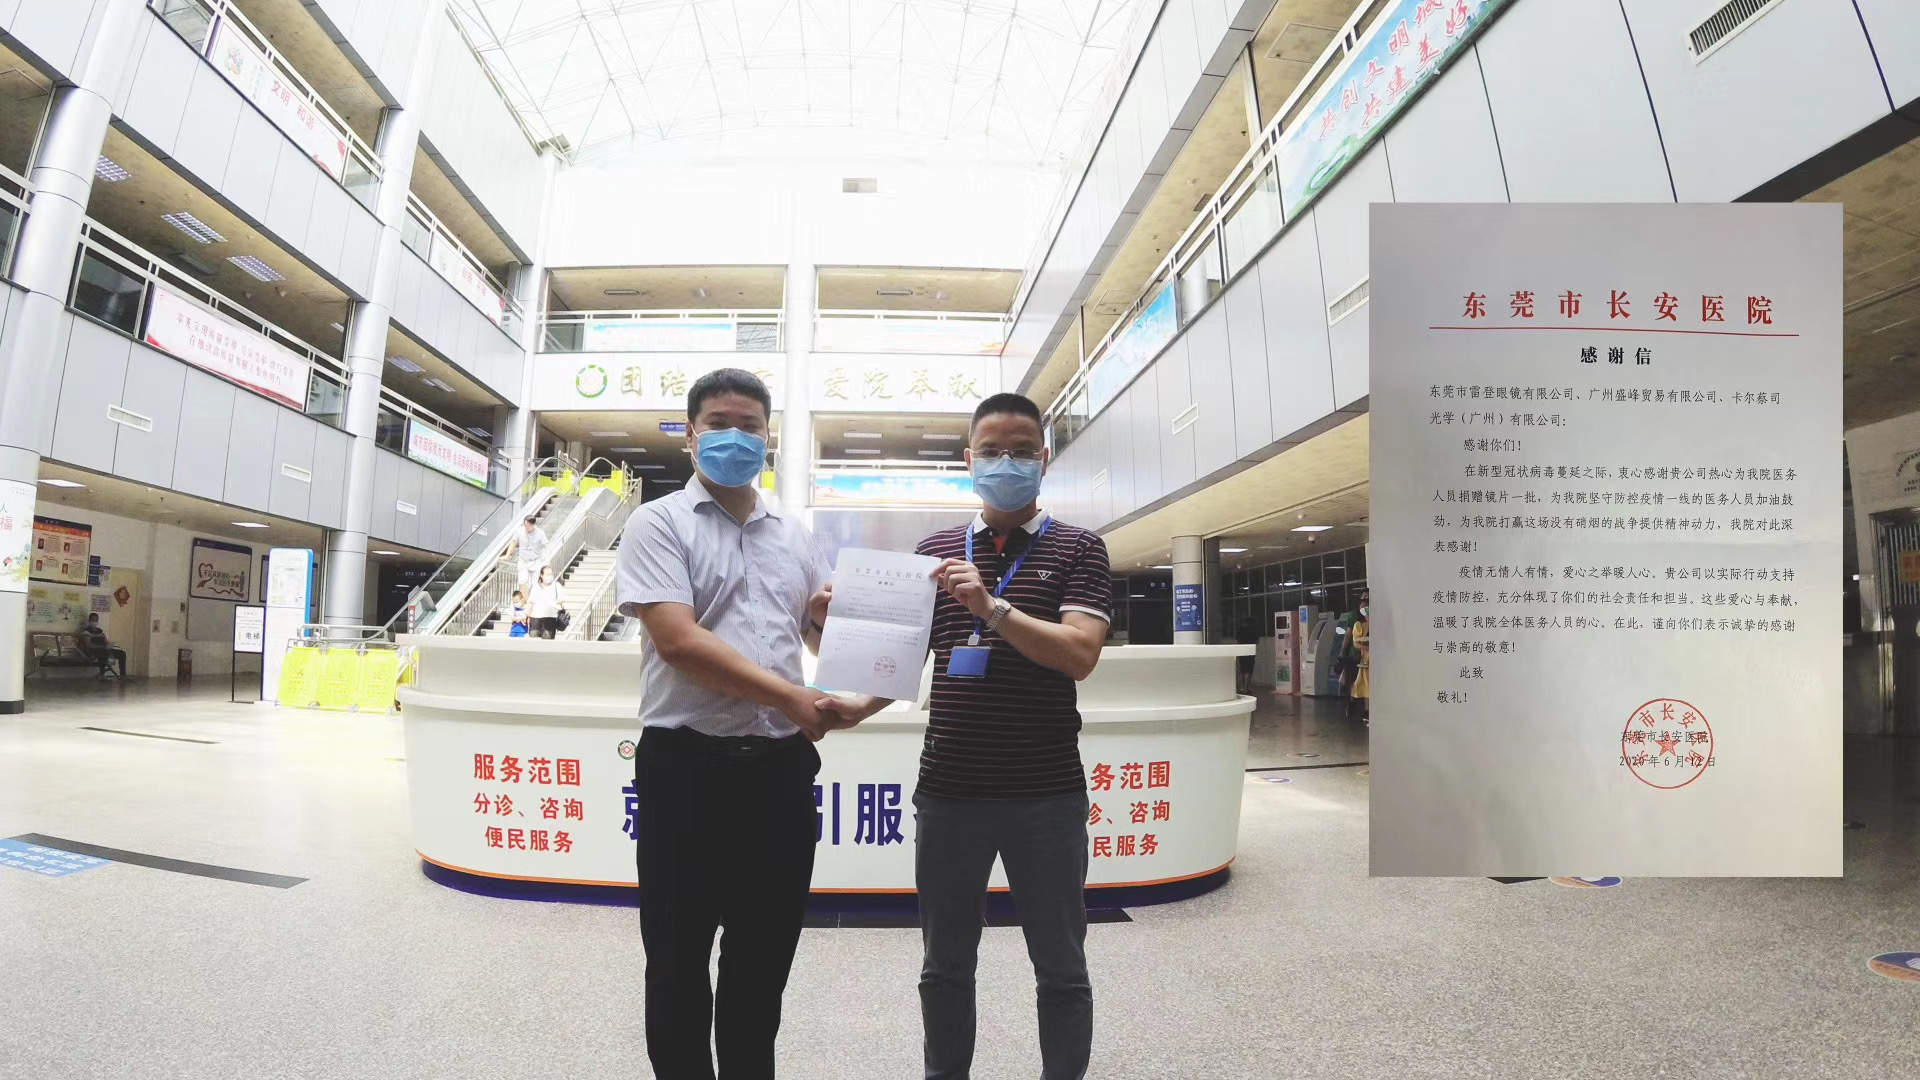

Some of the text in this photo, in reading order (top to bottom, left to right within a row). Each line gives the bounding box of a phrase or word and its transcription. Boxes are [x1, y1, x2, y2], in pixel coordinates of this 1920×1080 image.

[271, 80, 291, 107] 文明
[297, 104, 315, 131] 和谐
[1462, 289, 1773, 325] 东莞市长安医院
[1580, 346, 1652, 366] 感谢信
[1429, 384, 1781, 405] 东莞市雷登眼镜有限公司、广州盛峰贸易有限公司、卡尔蔡司
[1463, 438, 1522, 452] 感谢你们！
[1464, 464, 1797, 481] 在新型冠状病毒蔓延之际，衷心感谢贵公司热心为我院医务
[1432, 489, 1794, 506] 人员捐赠镜片一批，为我院坚守防控疫情一线的医务人员加油鼓
[1433, 515, 1794, 531] 劲，为我院打赢这场没有硝烟的战争提供精神动力，我院对此深
[1433, 540, 1478, 553] 表感谢！
[1458, 565, 1795, 582] 疫情无情人有情，爱心之举暖人心。贵公司以实际行动支持
[1432, 590, 1799, 607] 疫情防控，充分体现了你们的社会责任和担当。这些爱心与奉献，
[1432, 616, 1796, 632] 温暖了我院全体医务人员的心。在此，谨向你们表示诚挚的感谢
[246, 632, 261, 640] 电梯
[1433, 641, 1516, 654] 与崇高的敬意！
[1459, 666, 1484, 679] 此致
[1437, 691, 1468, 704] 敬礼！
[1621, 730, 1709, 744] 东莞市长安医院
[474, 753, 580, 786] 服务范围
[474, 792, 584, 821] 分诊、咨询
[813, 782, 919, 846] 引服
[485, 826, 573, 853] 便民服务
[1092, 833, 1158, 858] 民服务
